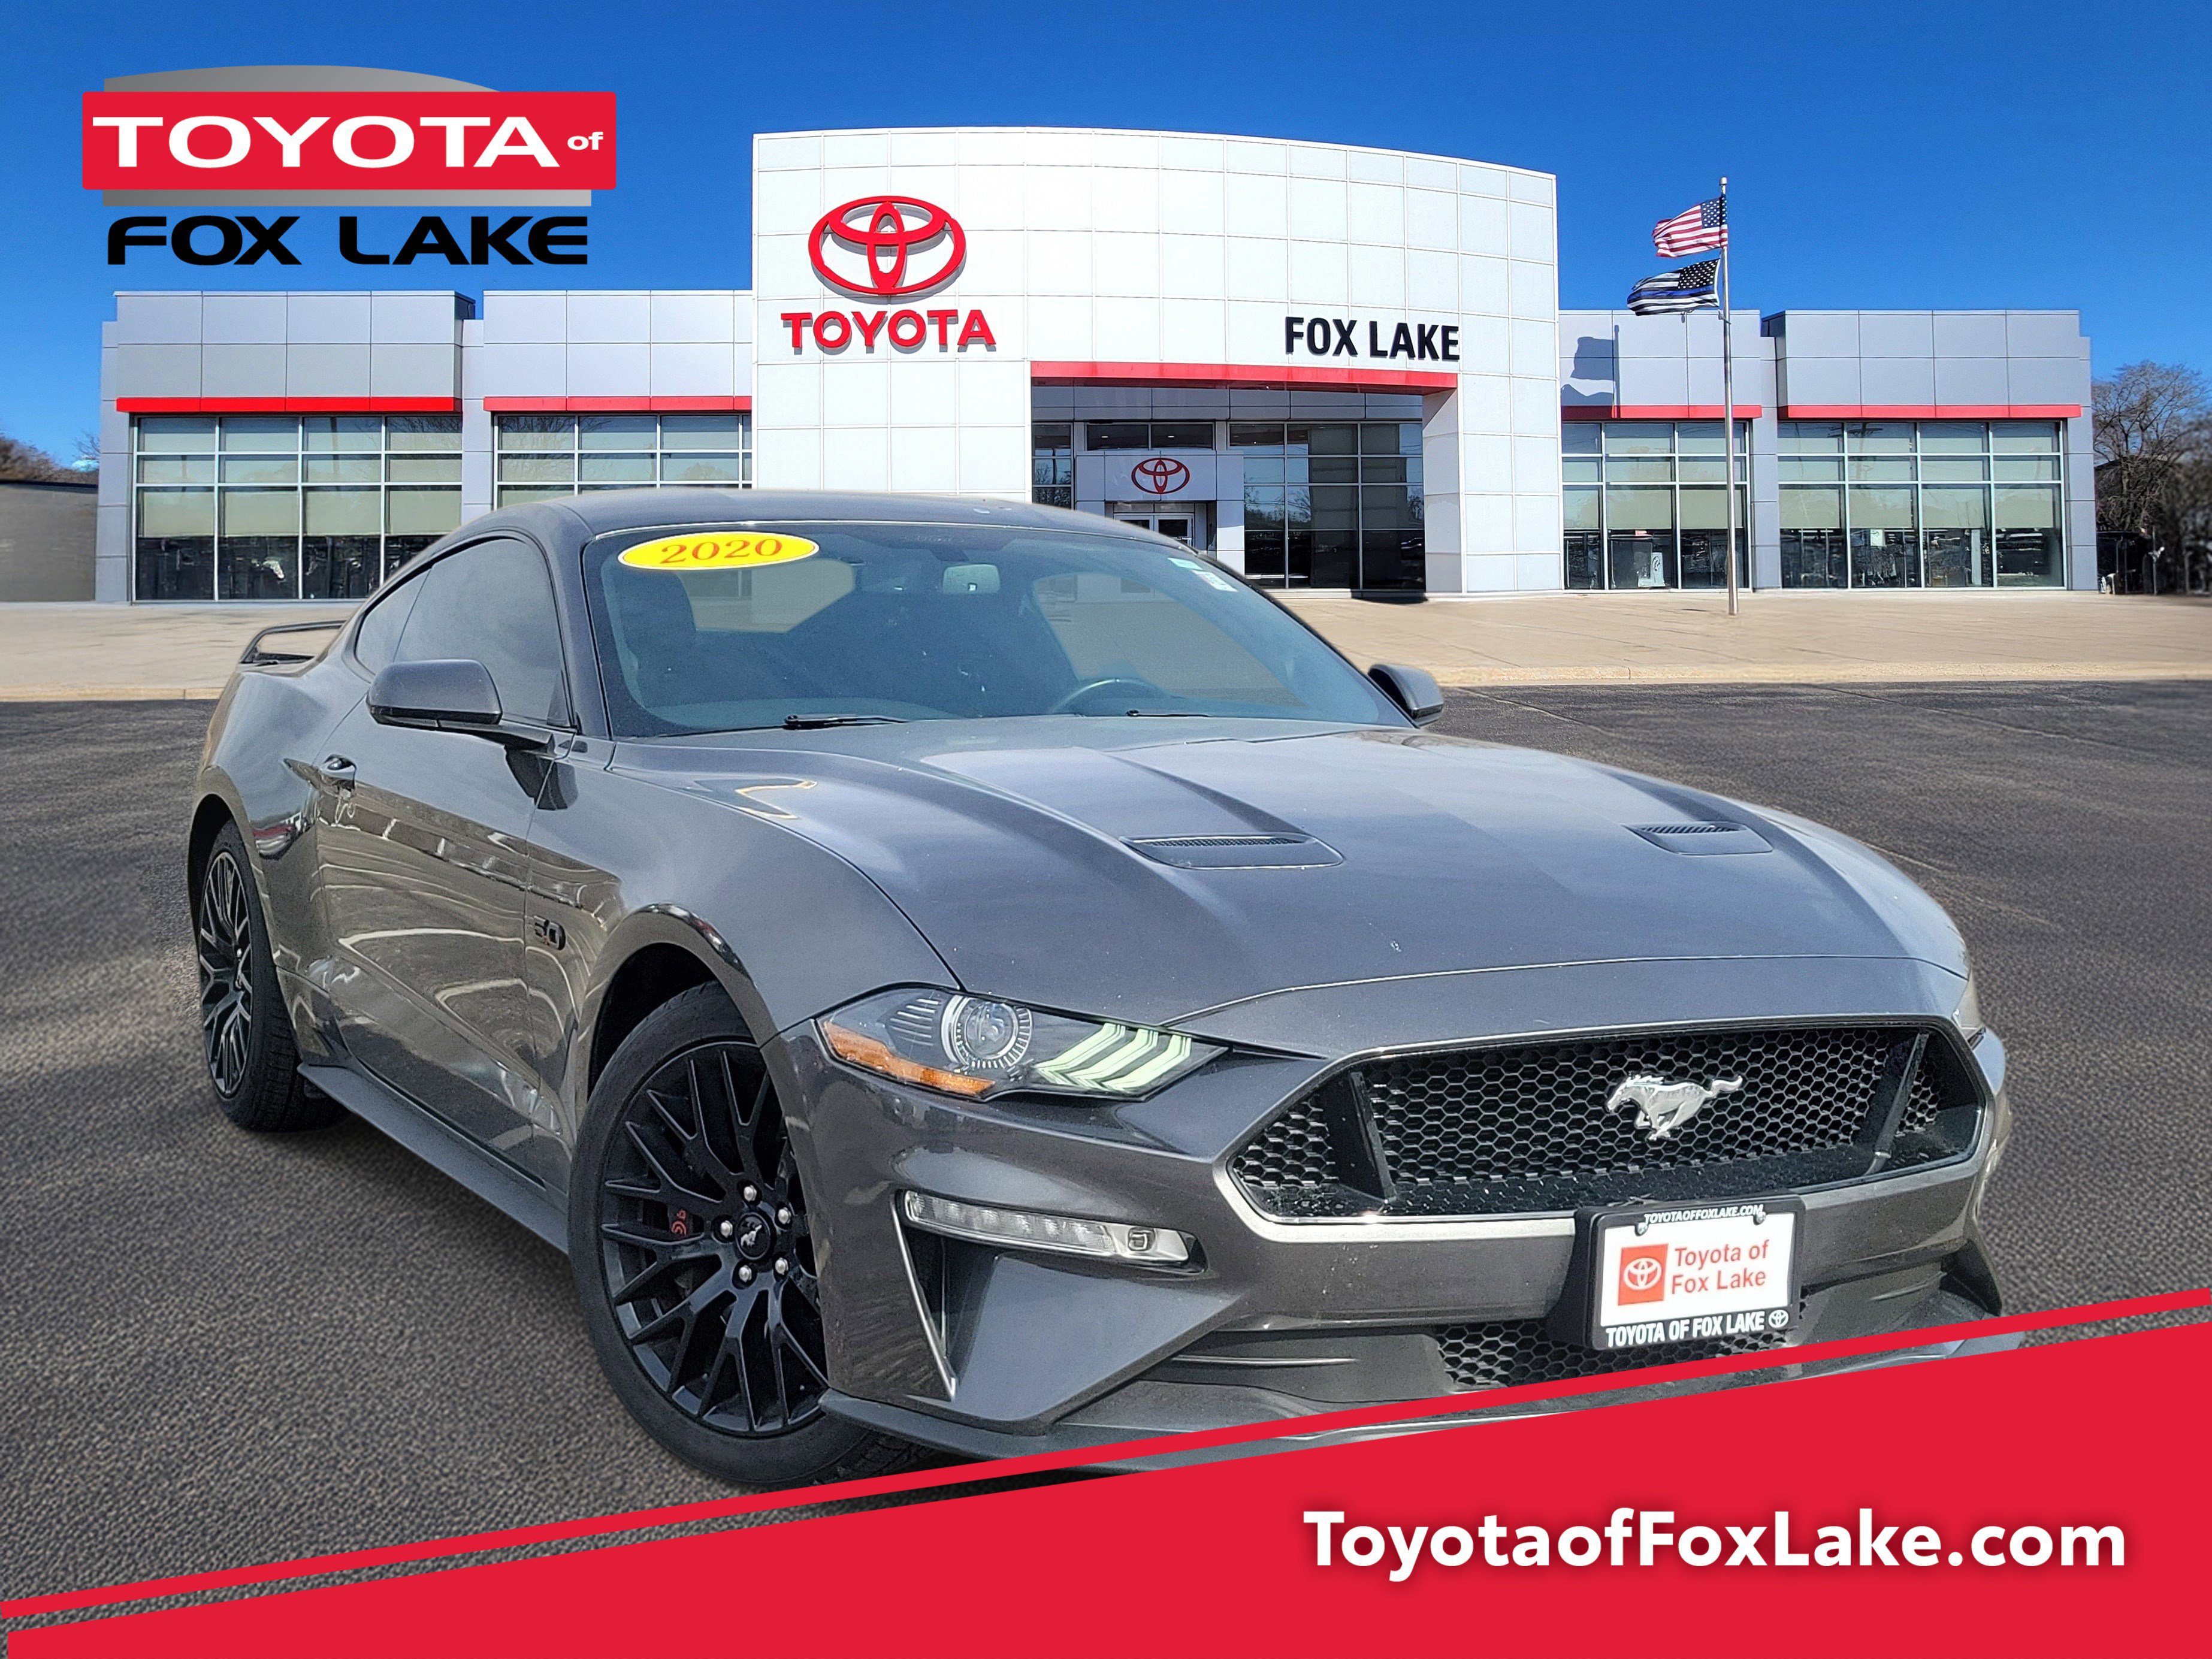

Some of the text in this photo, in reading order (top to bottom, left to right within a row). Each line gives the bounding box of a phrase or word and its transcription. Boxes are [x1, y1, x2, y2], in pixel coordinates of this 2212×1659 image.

[781, 309, 996, 348] TOYOTA
[1285, 316, 1460, 361] FOX LAKE
[660, 539, 783, 564] 2020
[1644, 1204, 1764, 1225] TOYOTAOFFOXLAKE.COM
[1675, 1240, 1770, 1271] Toyota of
[1672, 1267, 1766, 1295] Fox Lake
[1606, 1311, 1766, 1347] TOYOTA OF FOX LAKE
